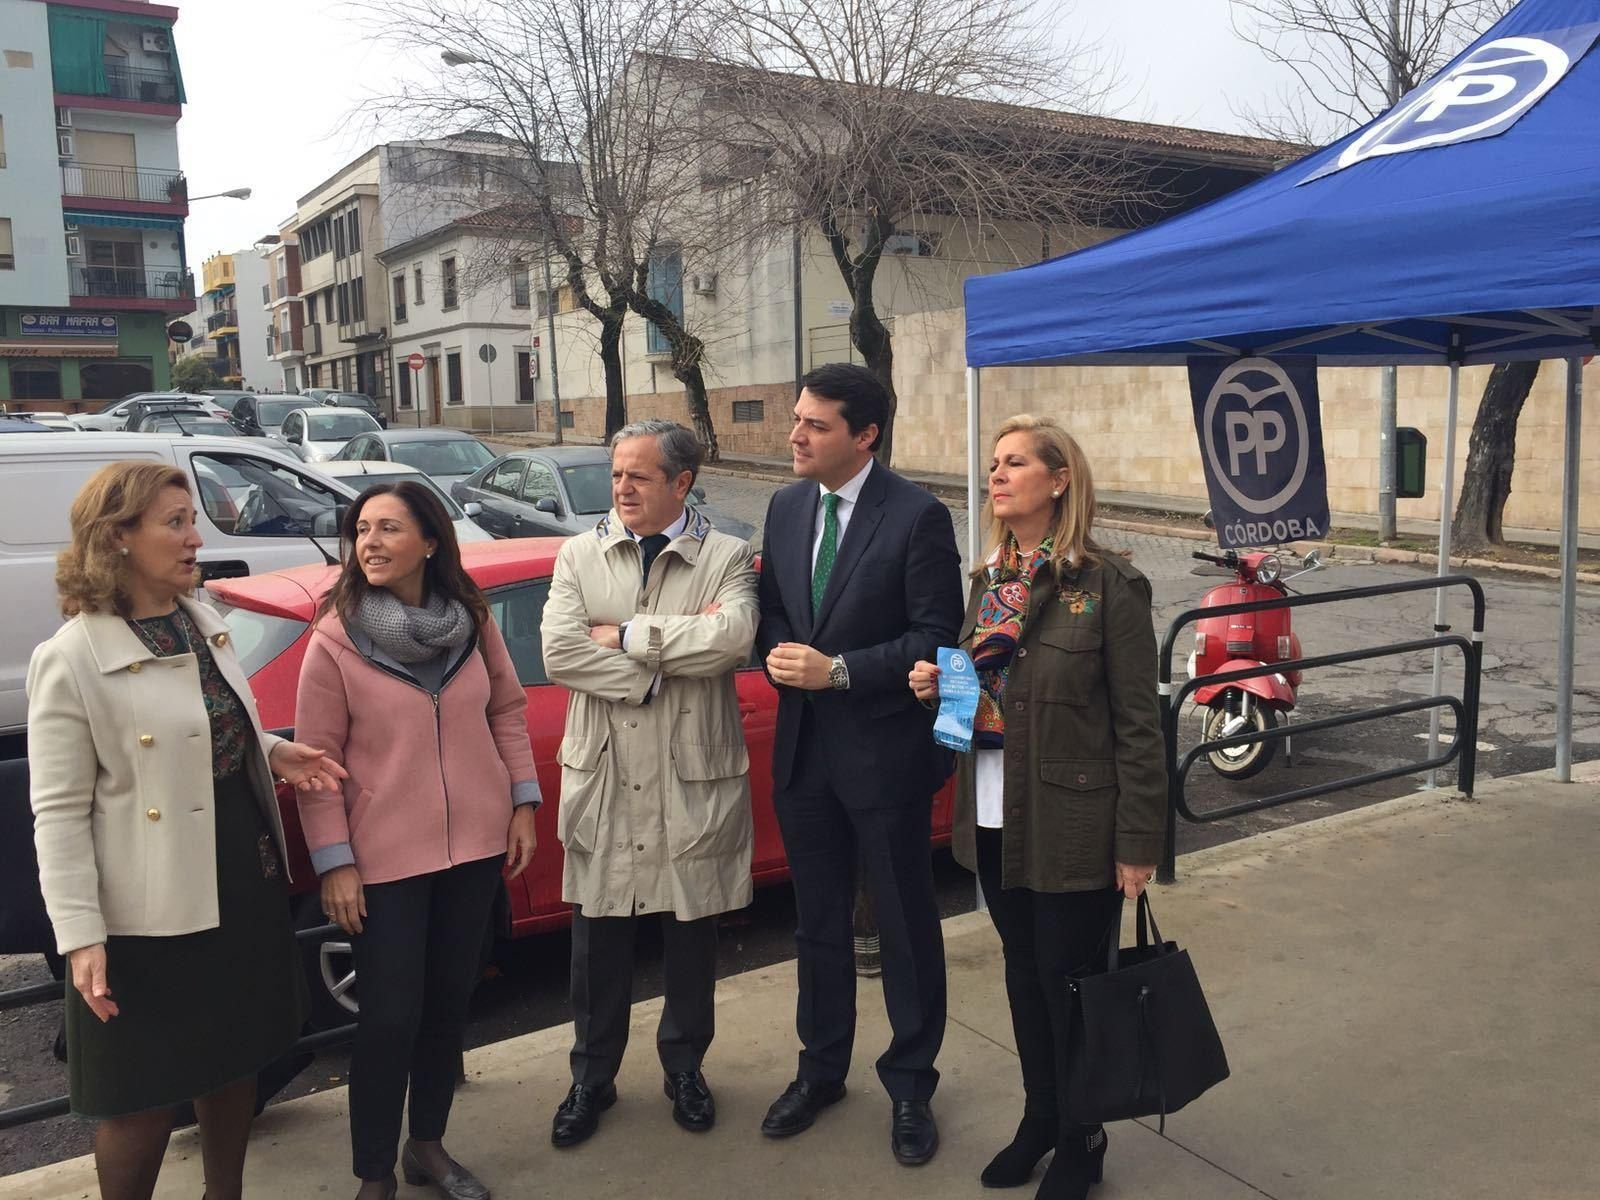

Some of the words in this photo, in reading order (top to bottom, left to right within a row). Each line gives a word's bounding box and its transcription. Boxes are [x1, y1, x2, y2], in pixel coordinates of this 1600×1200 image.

[39, 316, 60, 326] BAR
[1225, 410, 1286, 476] PP
[1225, 518, 1320, 545] CÓRDOBA
